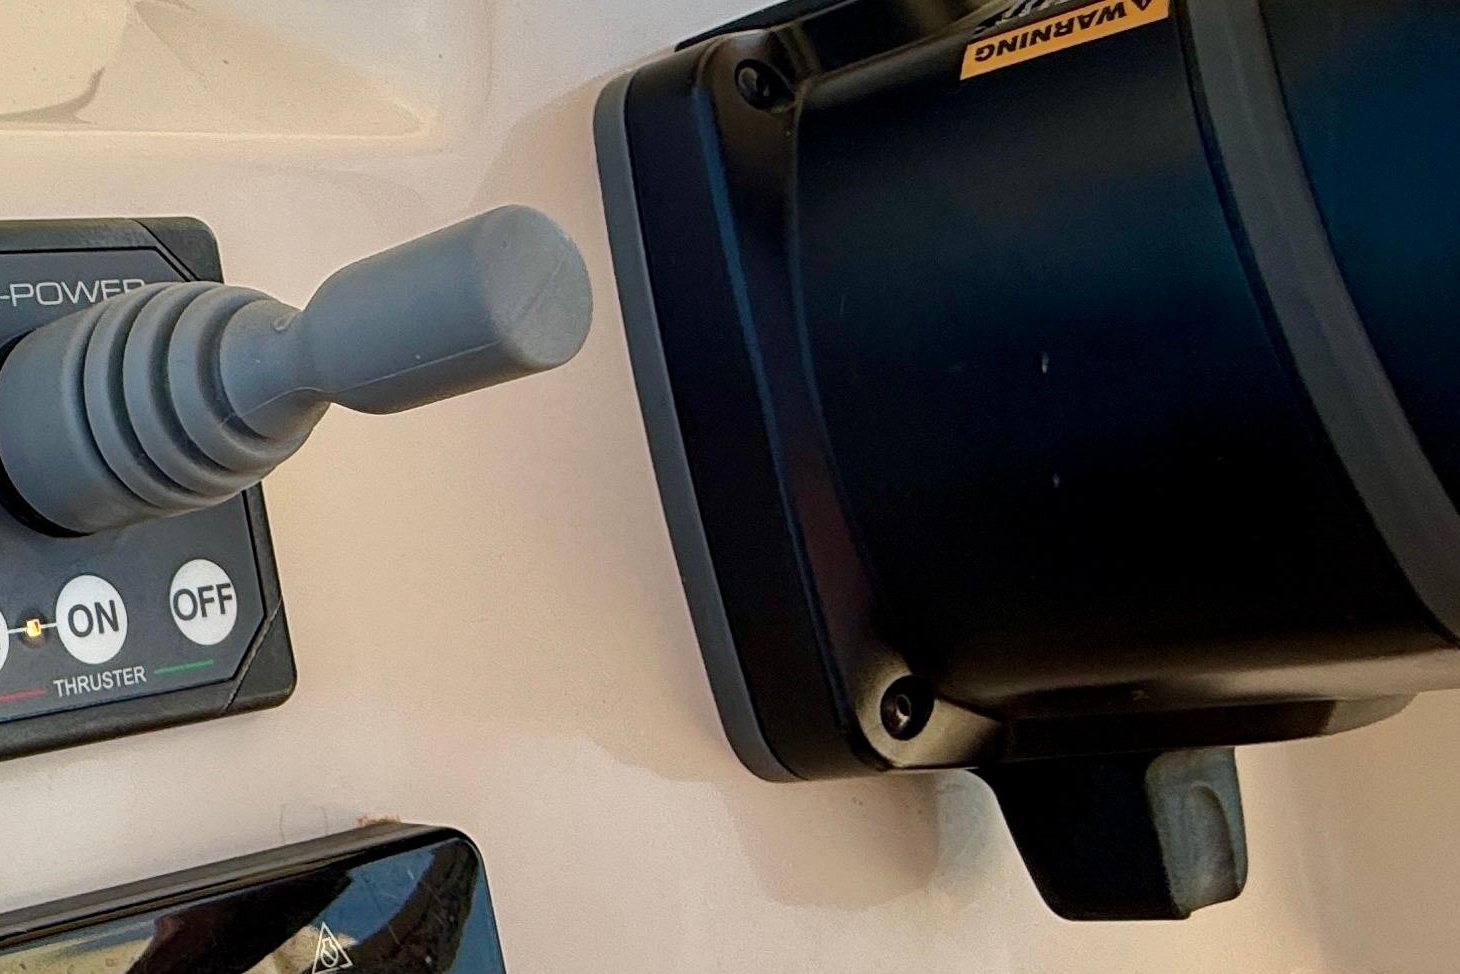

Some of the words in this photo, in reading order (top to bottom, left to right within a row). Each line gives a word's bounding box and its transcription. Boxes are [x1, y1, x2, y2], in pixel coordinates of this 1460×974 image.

[974, 2, 1127, 62] WARNING
[66, 598, 120, 639] ON
[172, 581, 234, 622] OFF
[53, 665, 147, 698] THRUSTER
